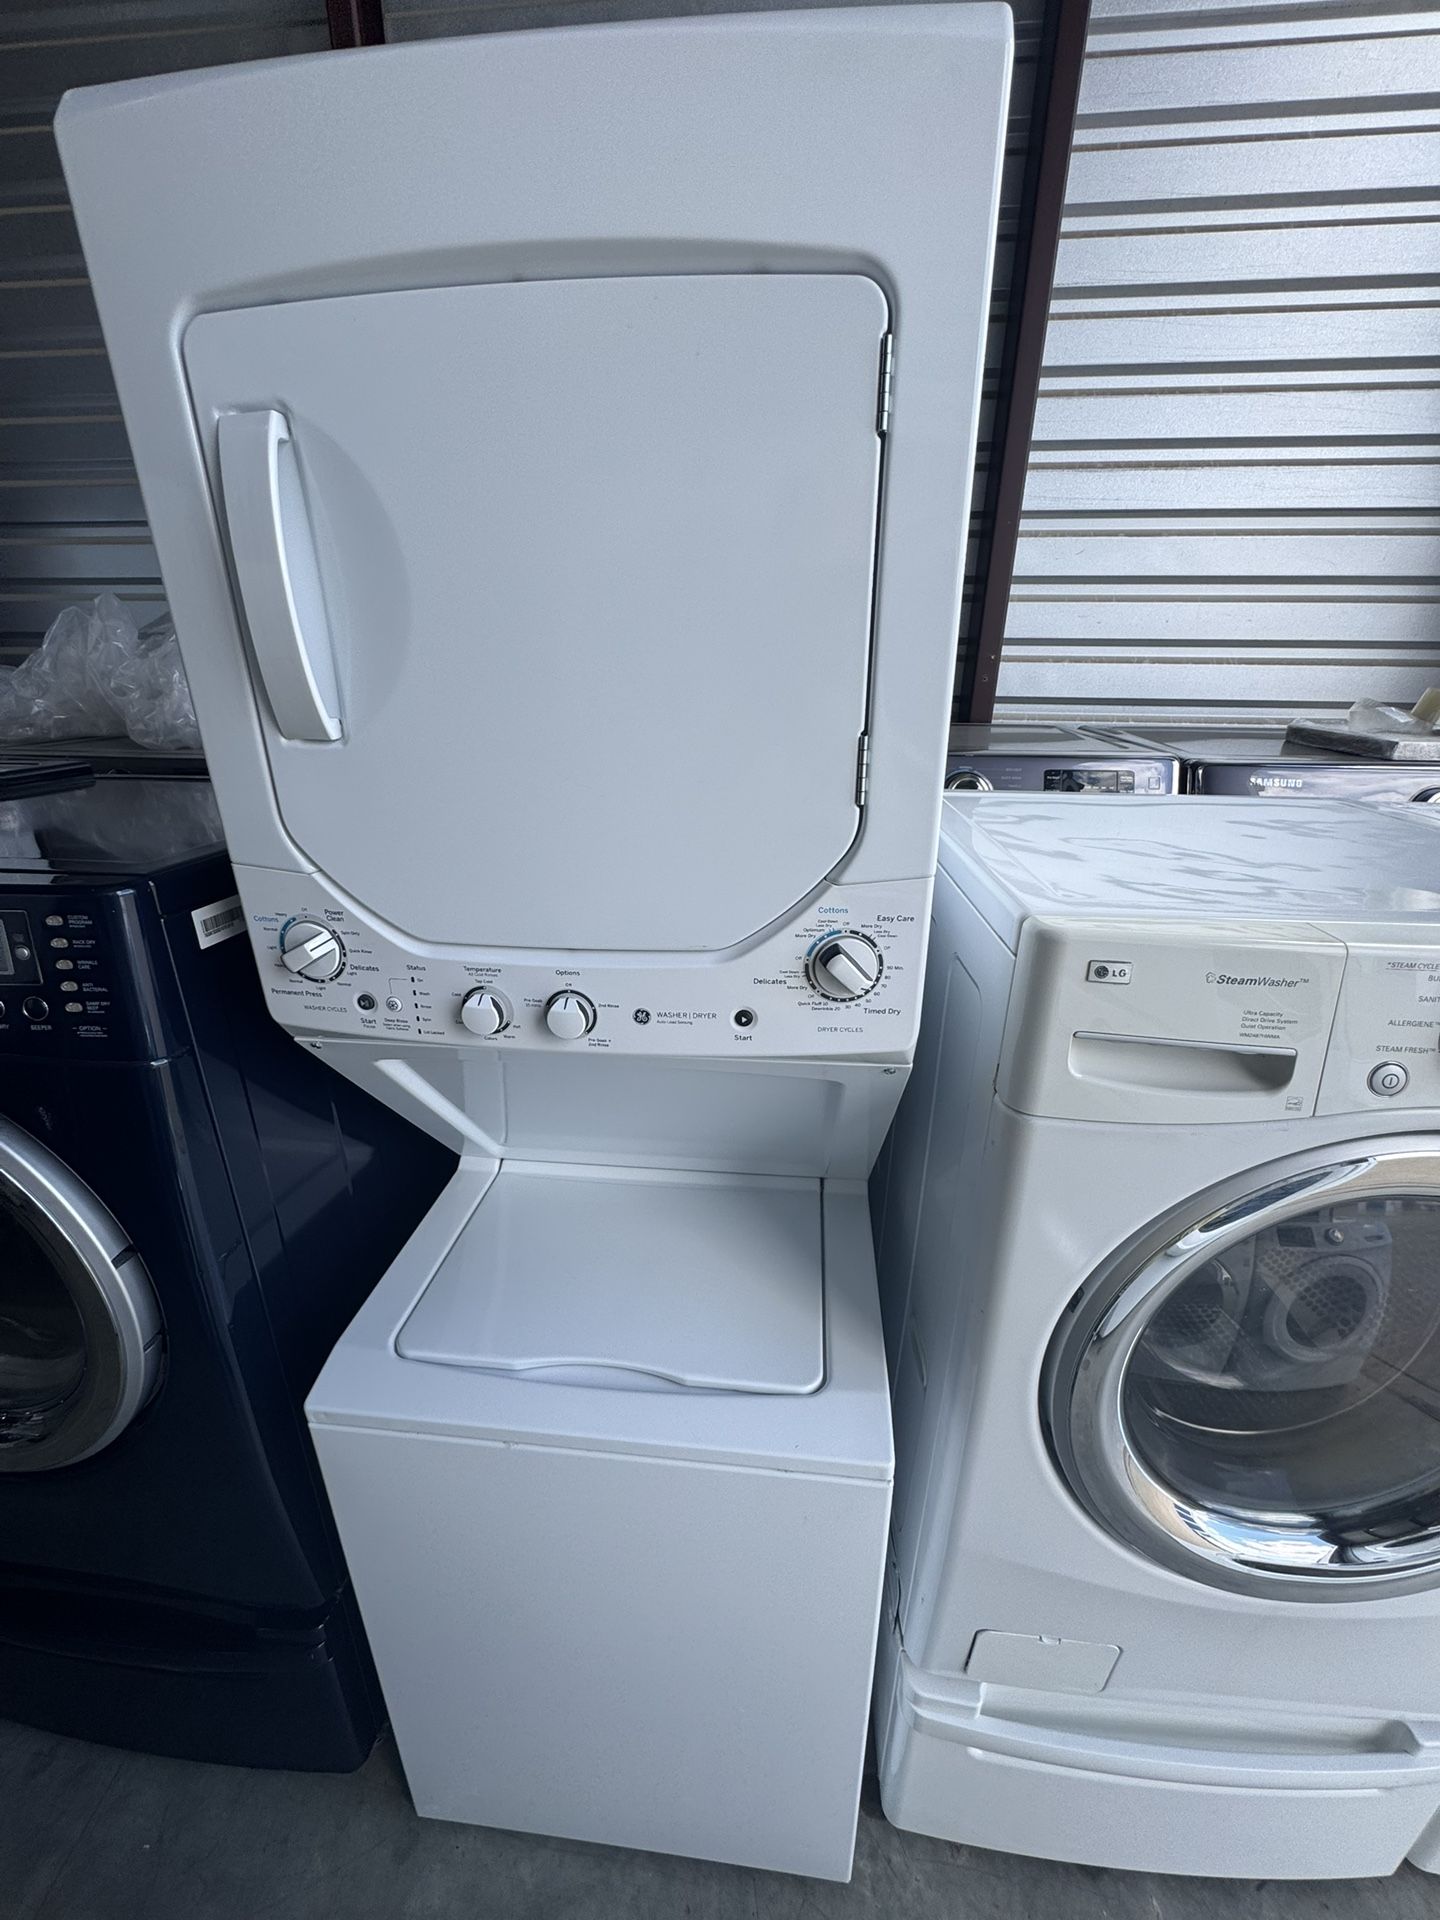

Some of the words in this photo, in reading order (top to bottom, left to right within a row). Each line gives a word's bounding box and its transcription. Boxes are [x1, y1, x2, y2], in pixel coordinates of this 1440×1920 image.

[1249, 777, 1303, 788] SAMSUNG
[324, 909, 344, 917] Power
[253, 915, 279, 923] Cottons
[326, 915, 344, 923] Clean
[877, 915, 895, 923] Easy
[350, 964, 380, 973] Delicates
[464, 966, 502, 974] Temperature
[271, 988, 304, 997] Permanent
[305, 990, 323, 998] Press
[304, 1004, 326, 1012] WASHER
[863, 1007, 887, 1015] Timed
[887, 1007, 901, 1016] Dry
[1376, 1045, 1403, 1053] STEAM
